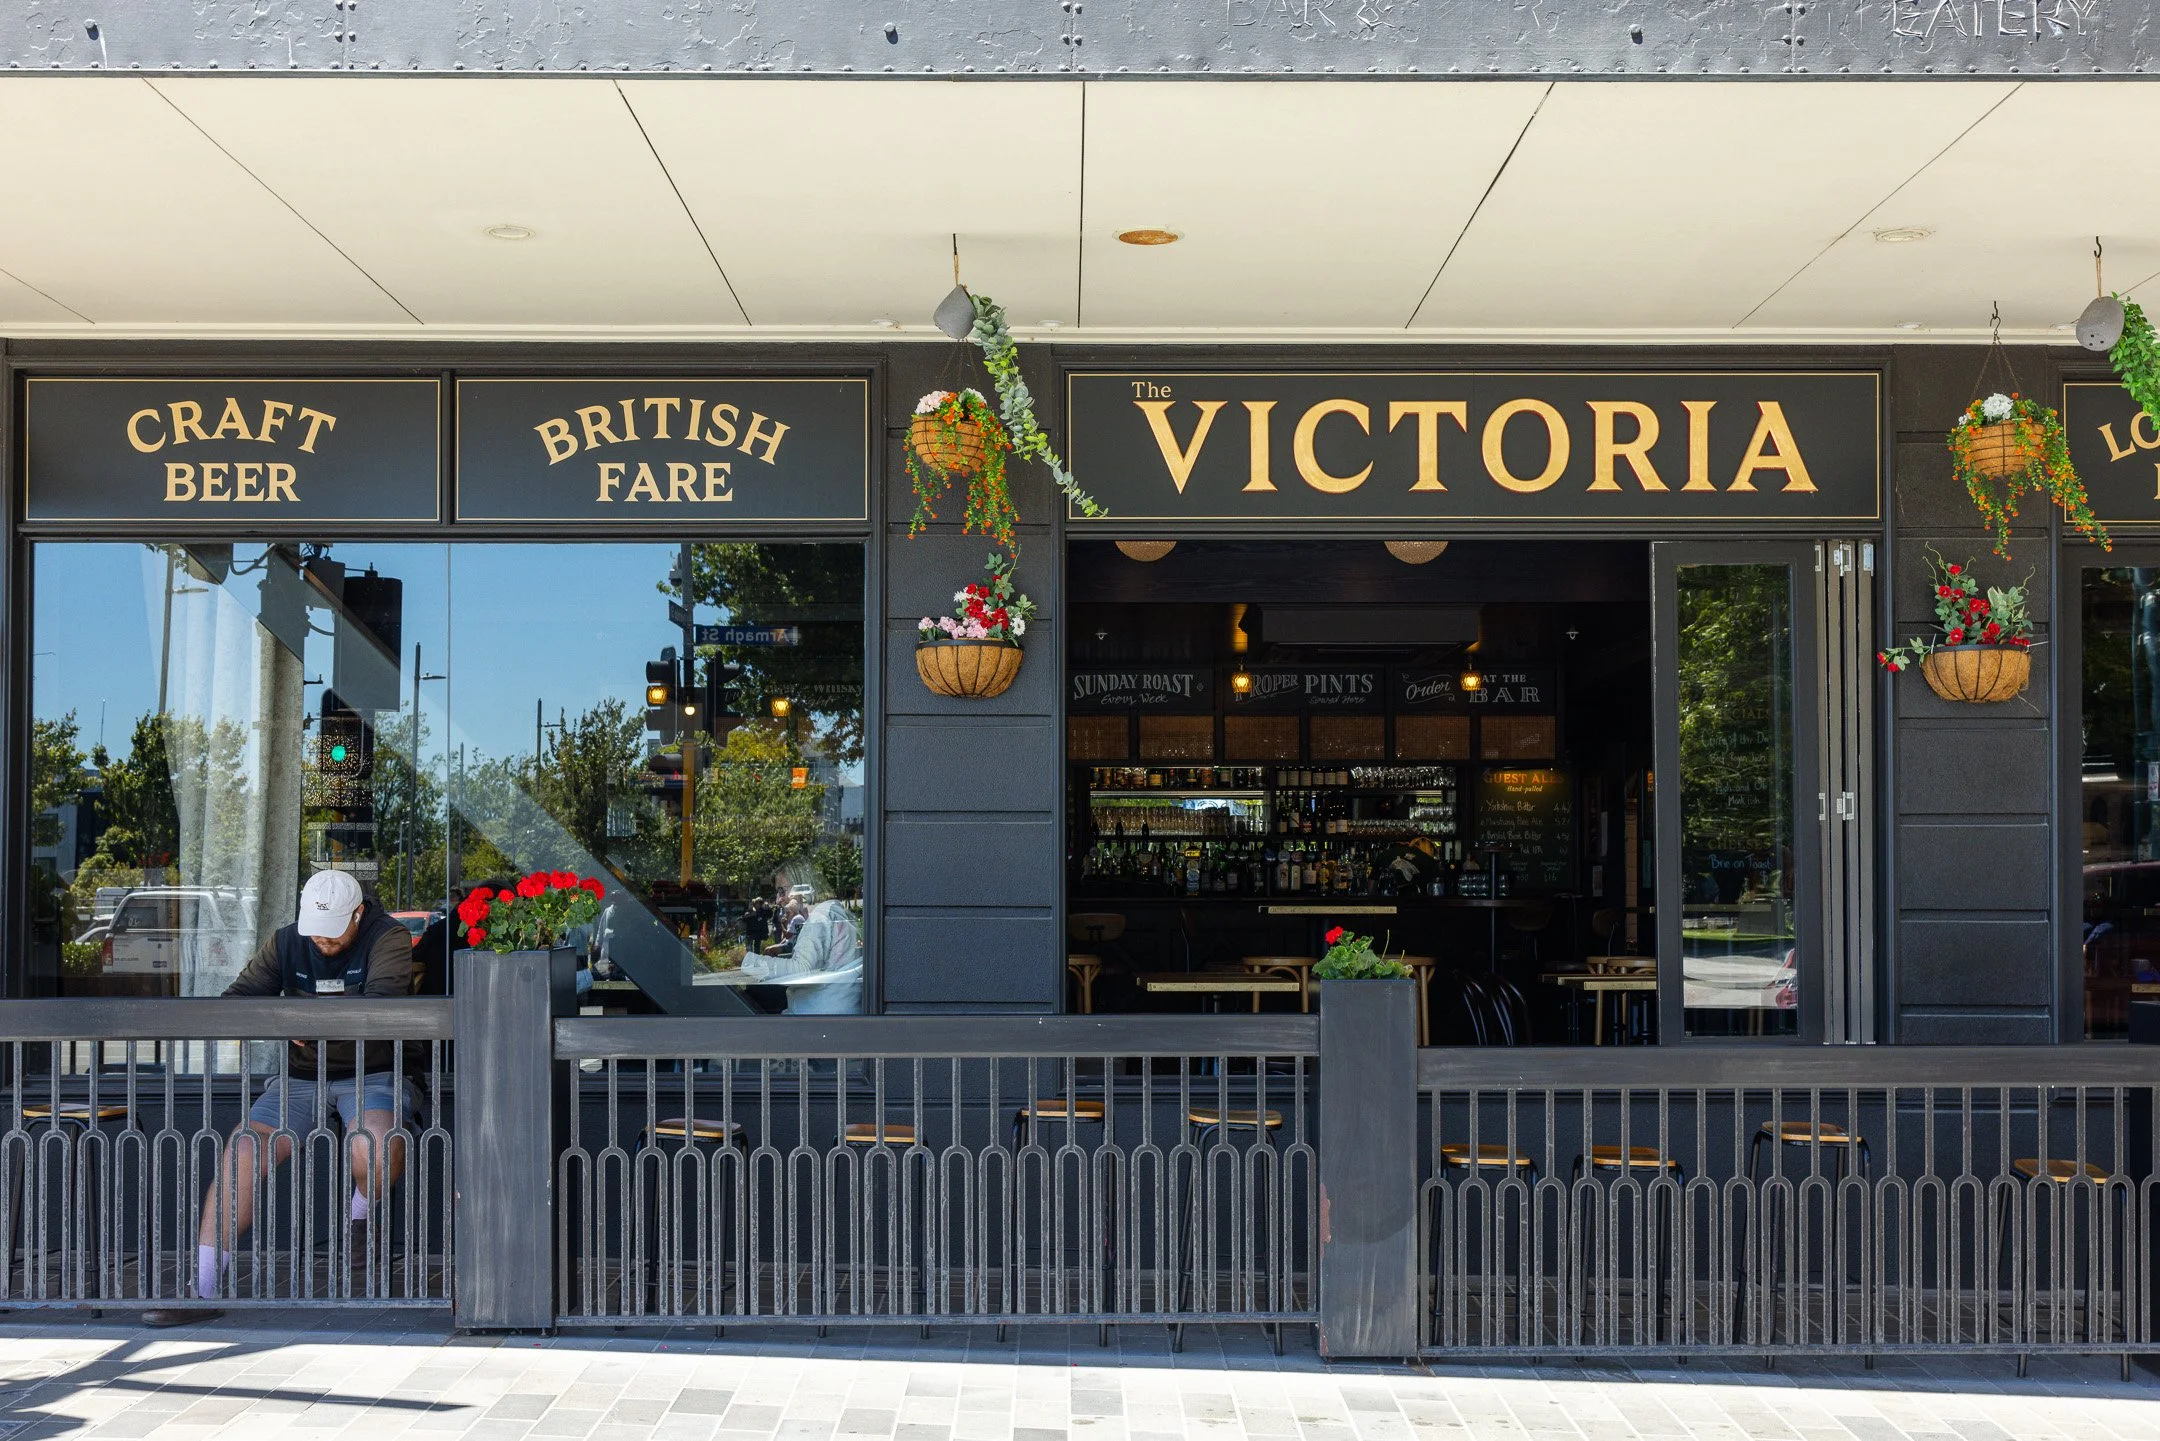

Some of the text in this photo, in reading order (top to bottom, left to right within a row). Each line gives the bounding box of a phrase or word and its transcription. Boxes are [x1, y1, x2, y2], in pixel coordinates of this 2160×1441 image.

[1131, 381, 1172, 399] The
[126, 397, 338, 455] CRAFT
[533, 397, 791, 467] BRITISH
[1135, 398, 1819, 495] VICTORIA
[163, 461, 302, 503] BEER
[596, 461, 734, 503] FARE
[1073, 673, 1194, 700] SUNDAY ROAST
[1235, 673, 1374, 702] ROPER PINTS
[1406, 680, 1451, 700] Order
[1481, 674, 1527, 683] AT THE
[1101, 693, 1168, 705] Every Week
[1469, 687, 1541, 703] BAR
[1483, 769, 1527, 784] GUEST
[1733, 860, 1744, 869] on
